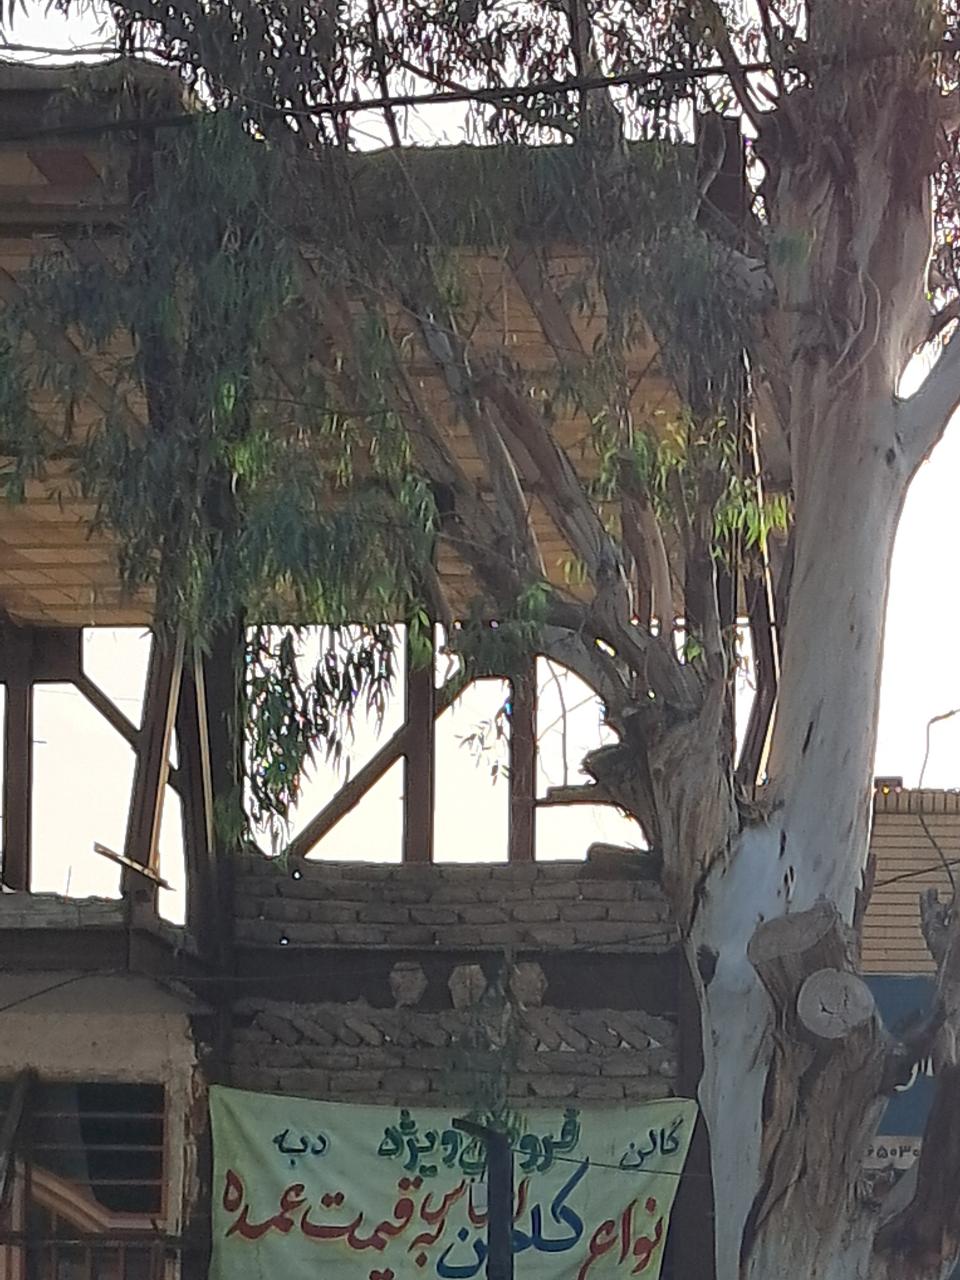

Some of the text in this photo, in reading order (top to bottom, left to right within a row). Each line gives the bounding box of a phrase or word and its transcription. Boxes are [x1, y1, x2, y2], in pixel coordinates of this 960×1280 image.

[273, 1128, 329, 1168] دبه
[377, 1108, 462, 1178] ویژه
[618, 1114, 684, 1168] گالن
[222, 1169, 308, 1240] عمده
[407, 1219, 446, 1268] به
